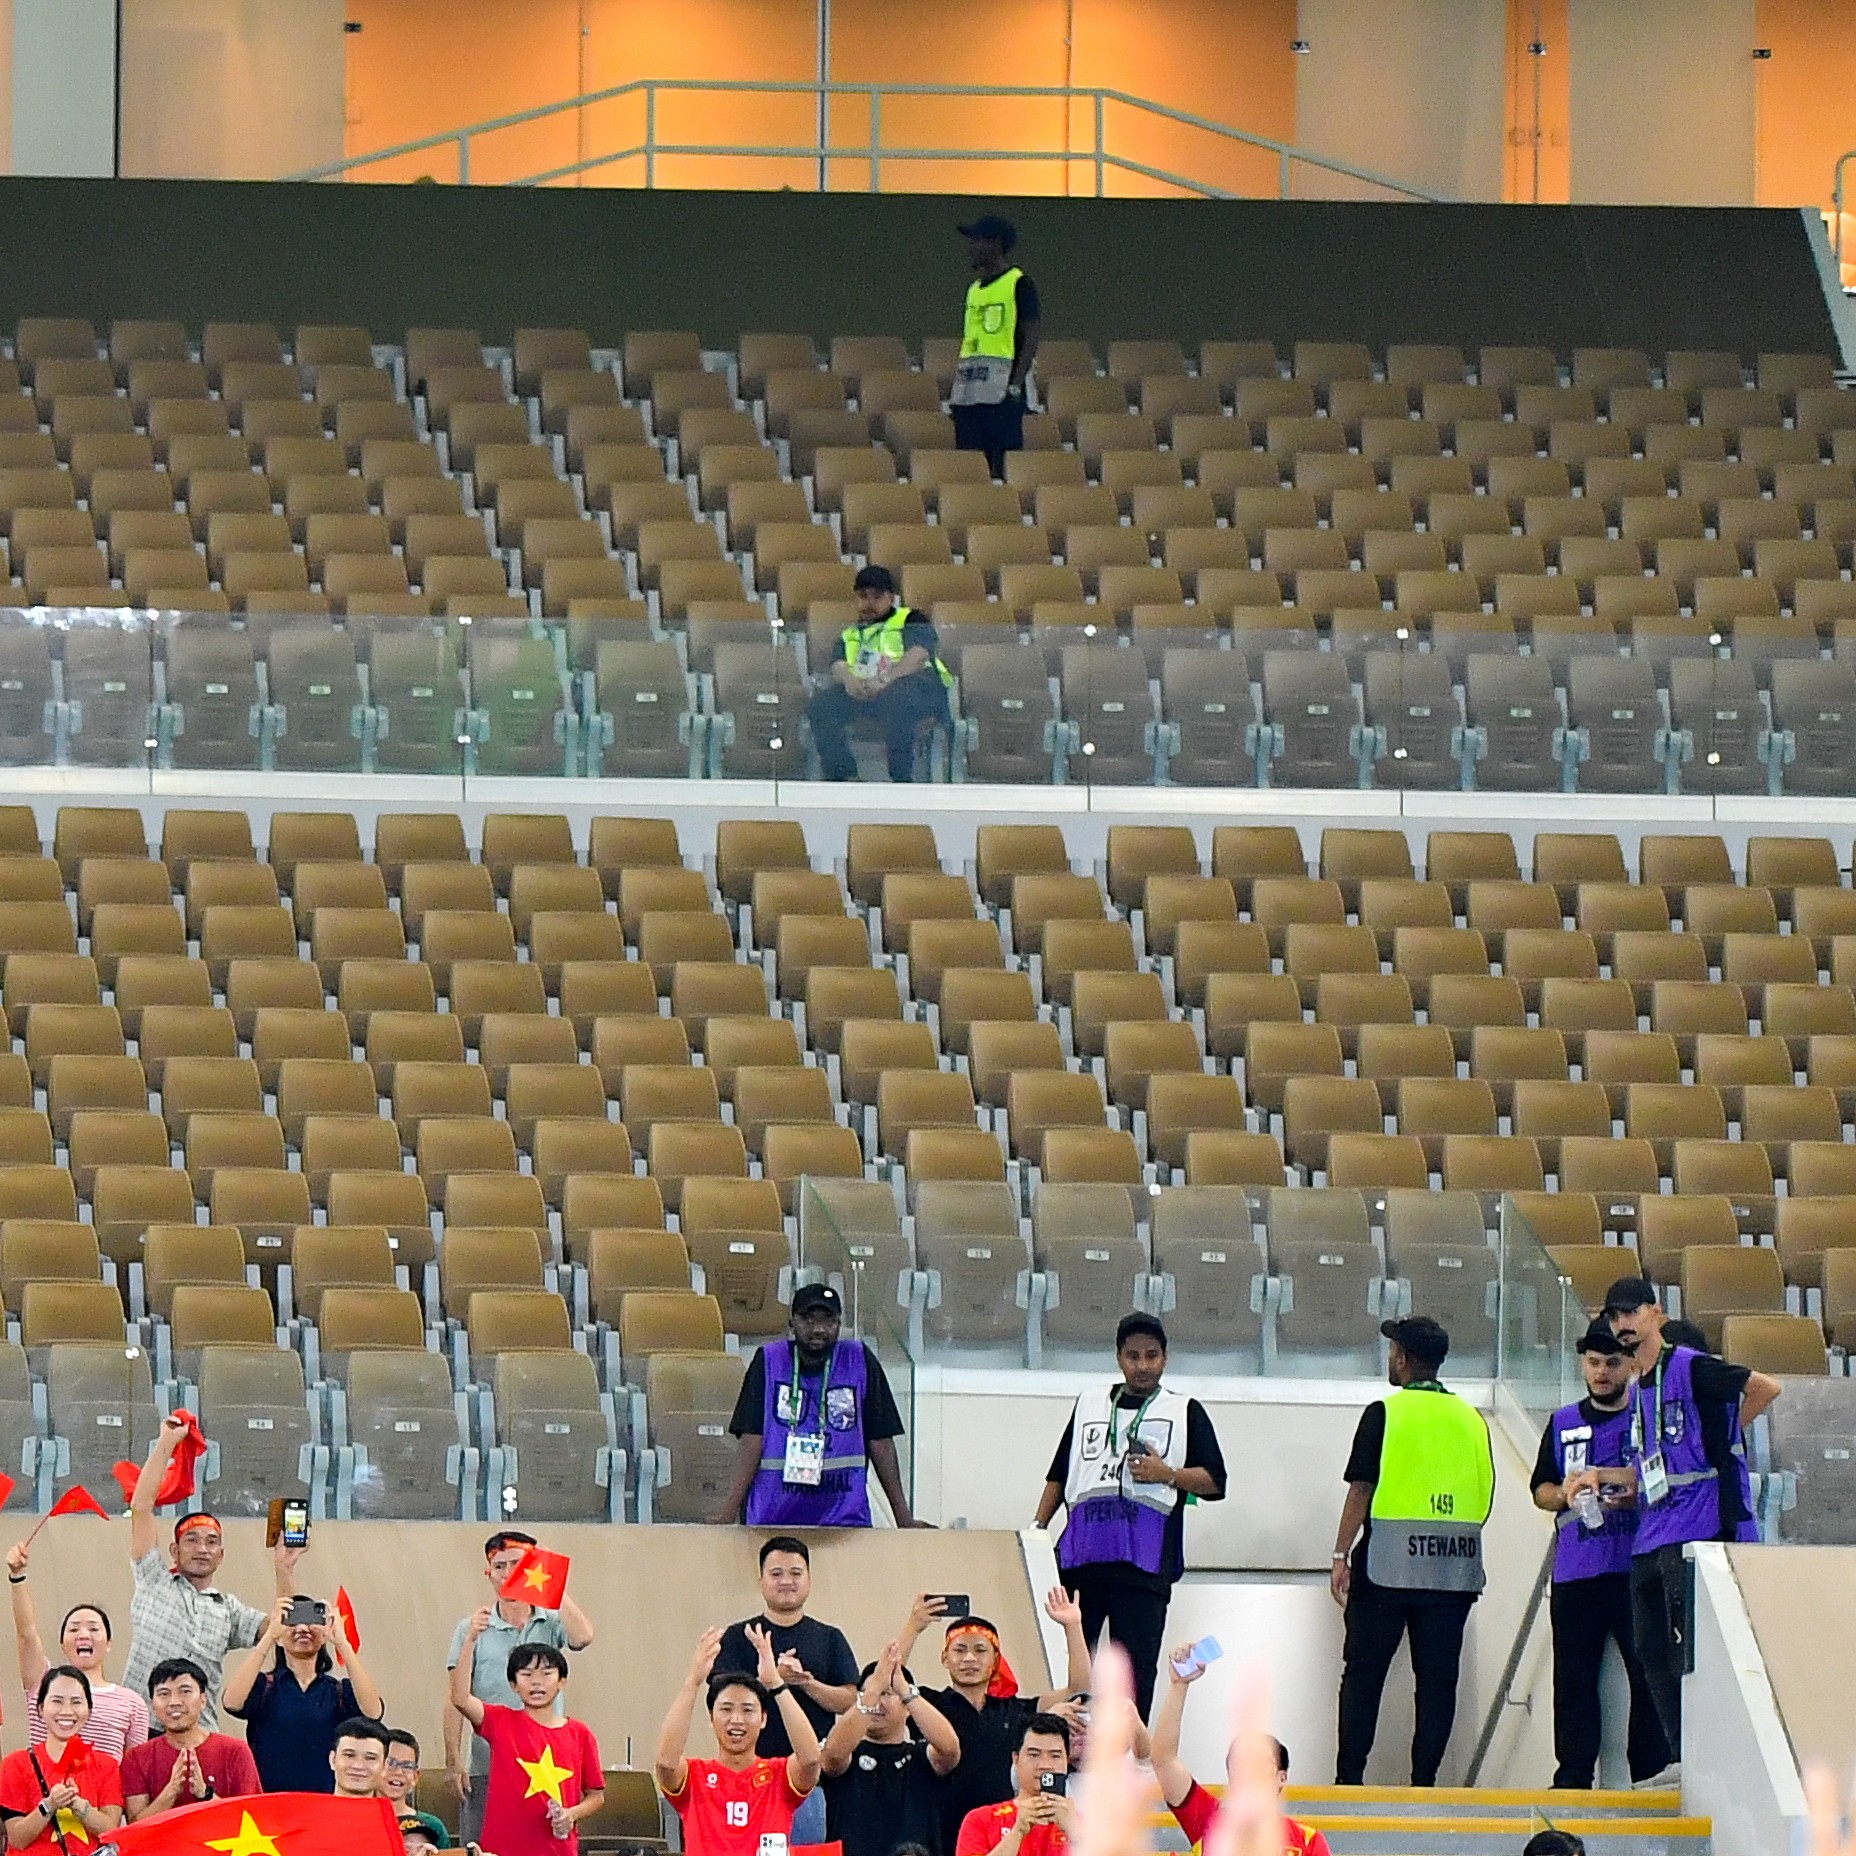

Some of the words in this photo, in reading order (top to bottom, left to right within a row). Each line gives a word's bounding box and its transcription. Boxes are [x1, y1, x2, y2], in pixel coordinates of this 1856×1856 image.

[1429, 1494, 1455, 1517] 1459
[1407, 1534, 1478, 1560] STEWARD
[725, 1800, 750, 1828] 19
